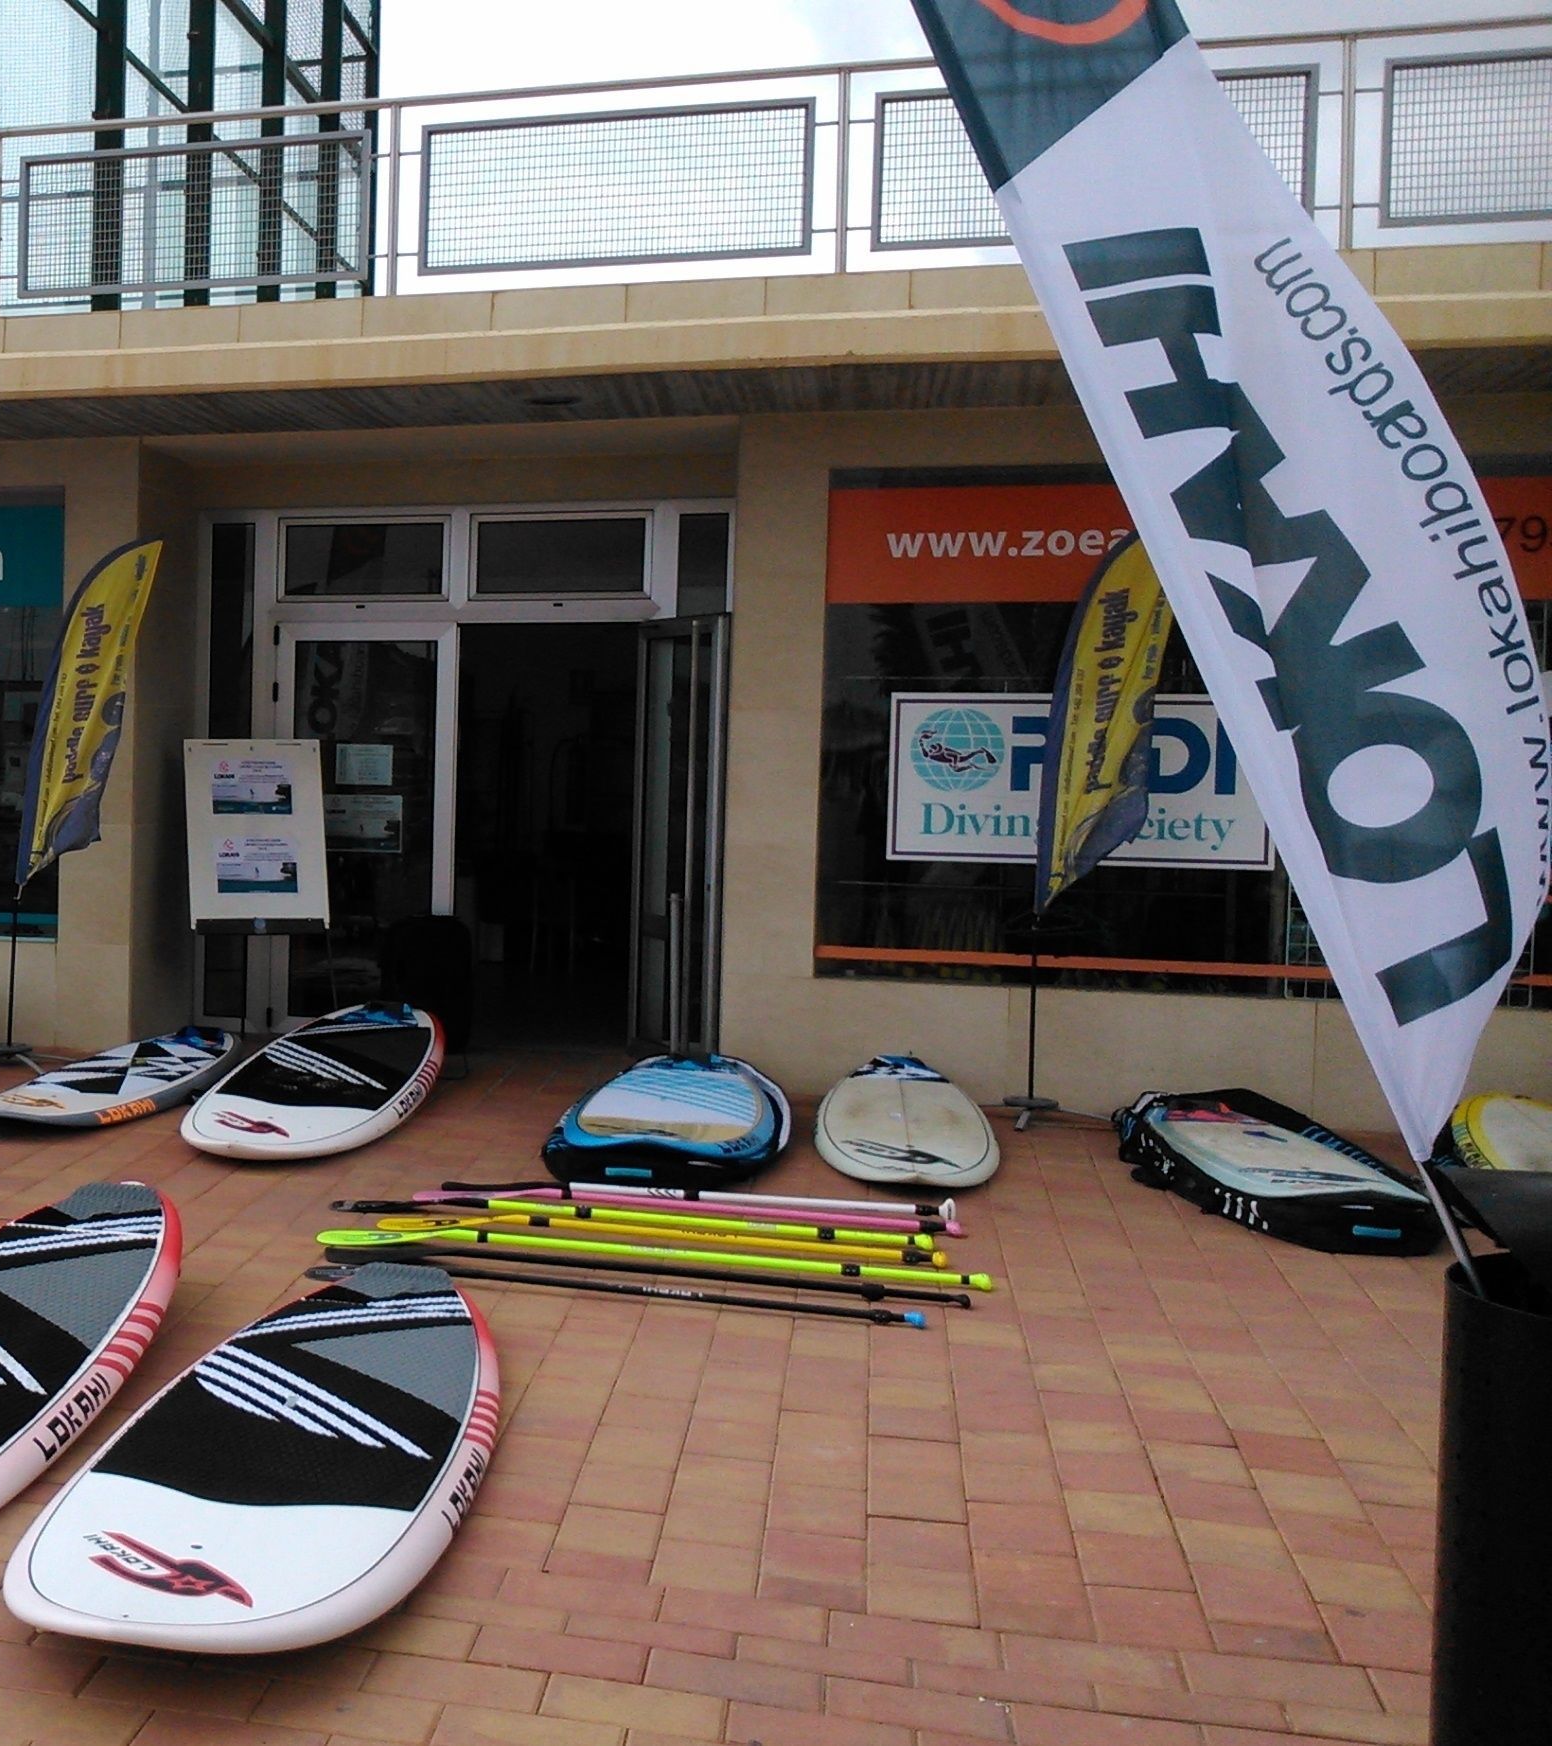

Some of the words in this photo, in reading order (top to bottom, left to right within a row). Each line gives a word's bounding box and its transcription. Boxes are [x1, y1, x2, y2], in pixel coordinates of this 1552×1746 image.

[76, 603, 112, 660] kayak
[1061, 227, 1513, 1027] LOKAHI
[1094, 587, 1139, 653] kayak
[1010, 715, 1237, 795] PDI
[920, 802, 1039, 845] Divin
[1145, 808, 1236, 850] ciety
[95, 1097, 157, 1125] LOKAHI
[32, 1371, 111, 1463] LOKAHI
[441, 1447, 484, 1535] LOKAHI
[83, 1533, 156, 1572] LOKAHI
